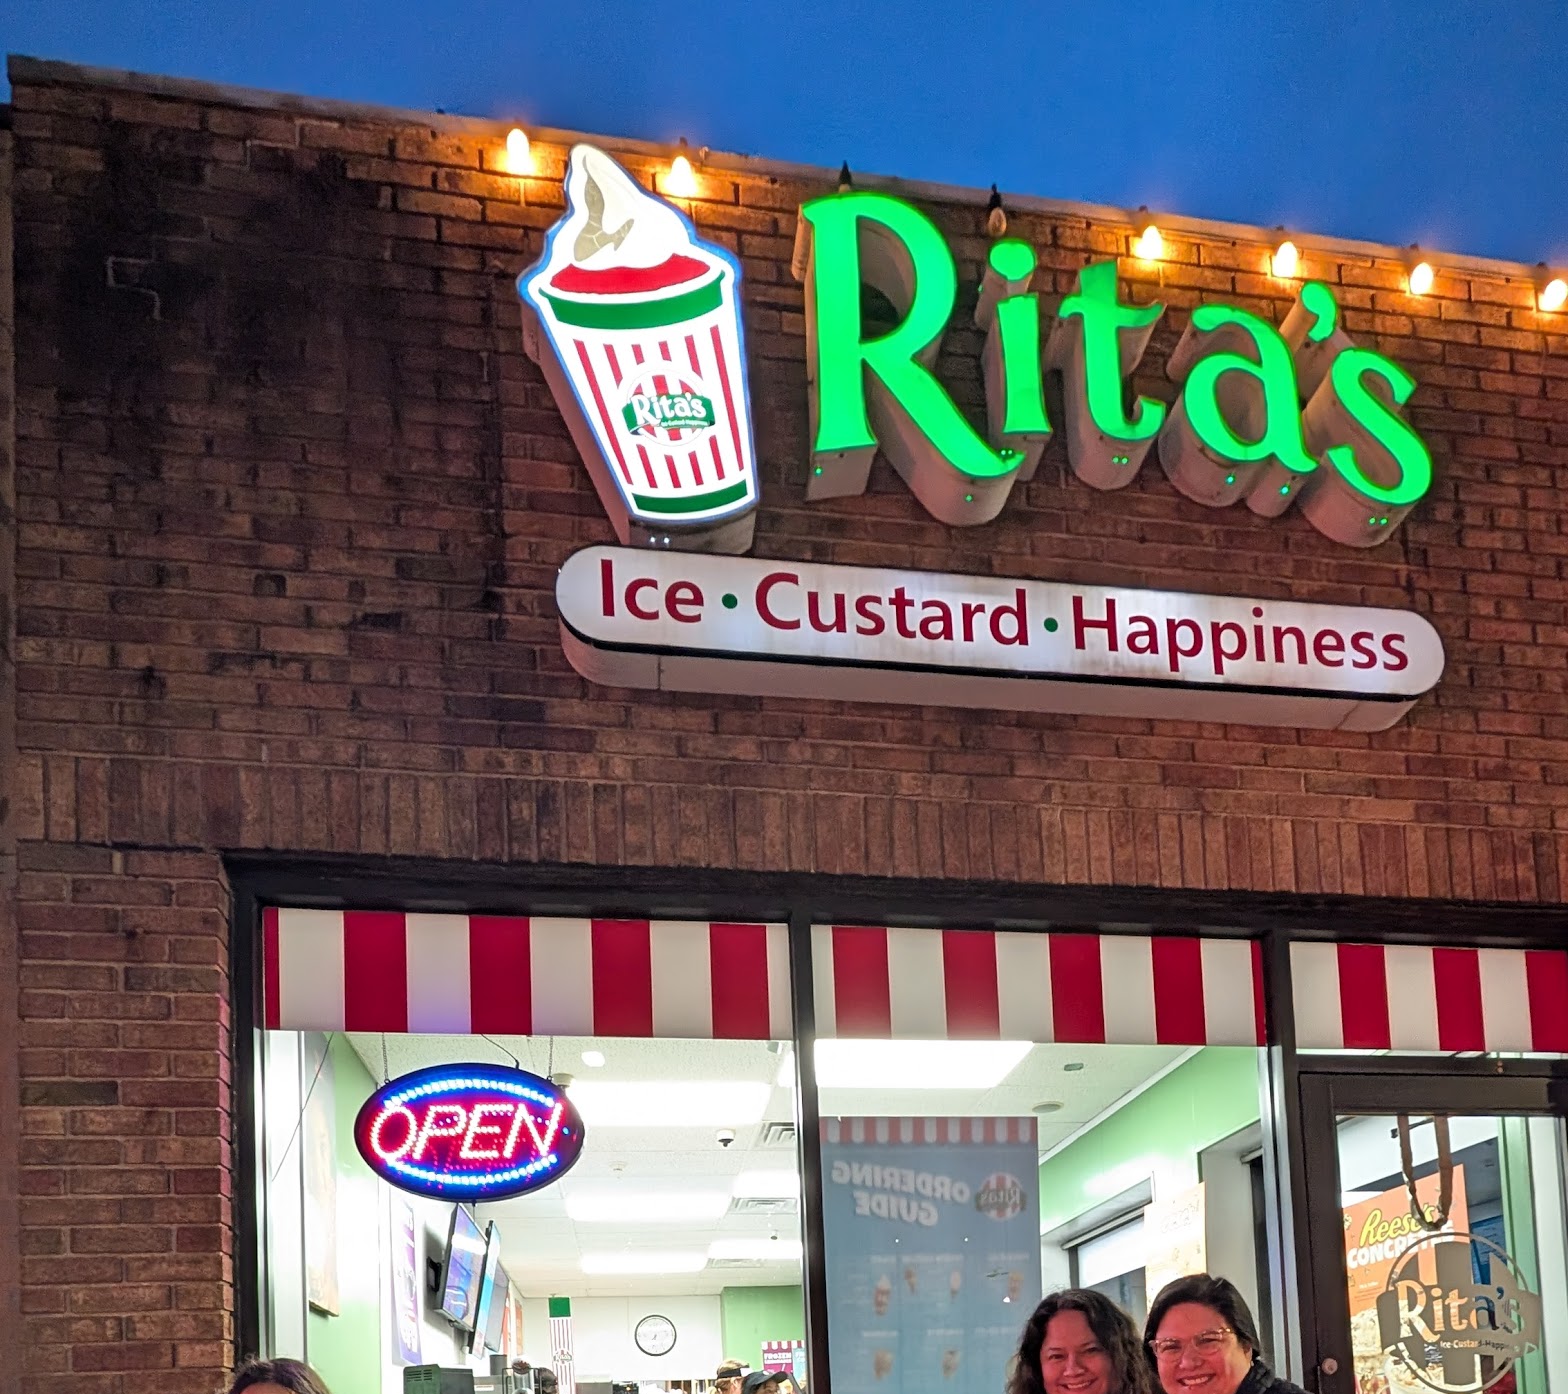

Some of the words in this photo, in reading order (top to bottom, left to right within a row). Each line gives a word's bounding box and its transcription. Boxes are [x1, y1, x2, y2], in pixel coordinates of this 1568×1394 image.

[803, 193, 1432, 504] Rita's
[630, 393, 707, 428] Rita's
[600, 559, 705, 624] Ice
[755, 571, 1030, 647] Custard
[1072, 595, 1409, 676] Happiness
[370, 1103, 563, 1161] OPEN
[1395, 1279, 1525, 1343] Rita's
